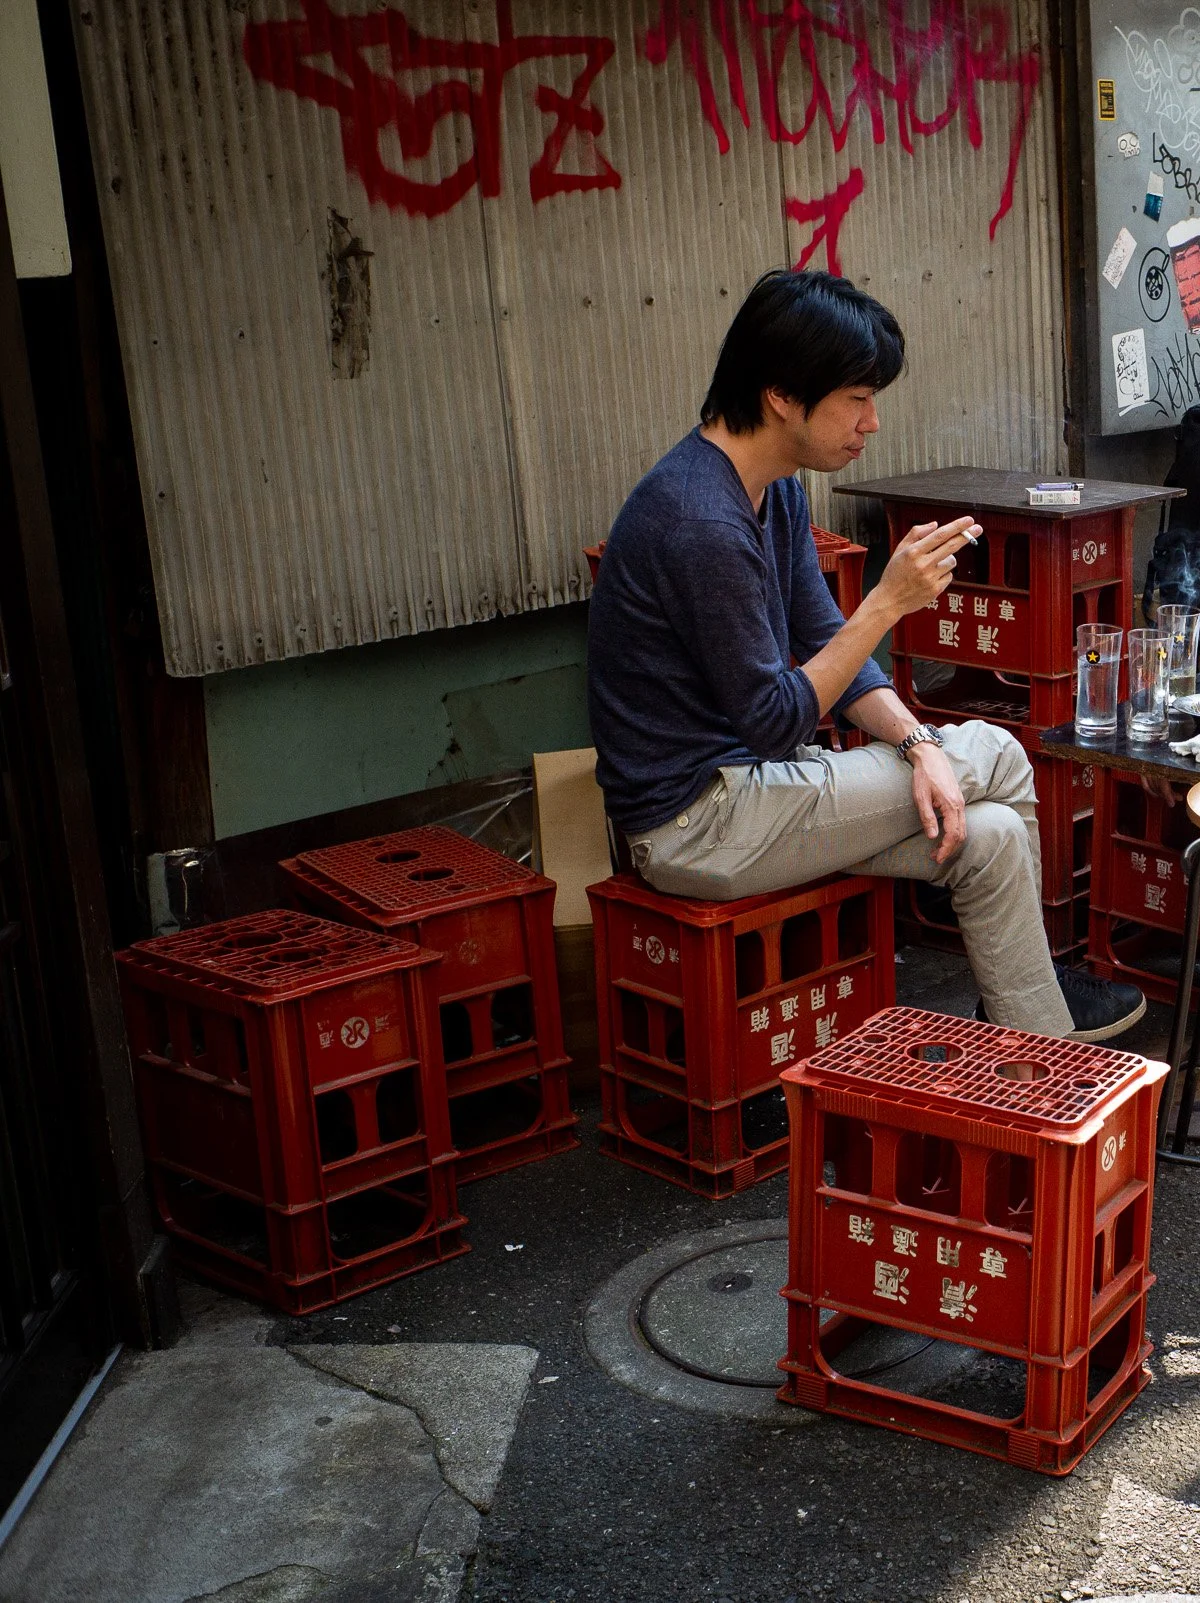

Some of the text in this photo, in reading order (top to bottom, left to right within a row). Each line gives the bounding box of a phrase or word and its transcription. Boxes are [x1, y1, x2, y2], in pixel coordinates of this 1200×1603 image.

[938, 619, 1000, 655] 清酒
[770, 1010, 840, 1067] 清酒
[872, 1259, 979, 1324] 清酒
